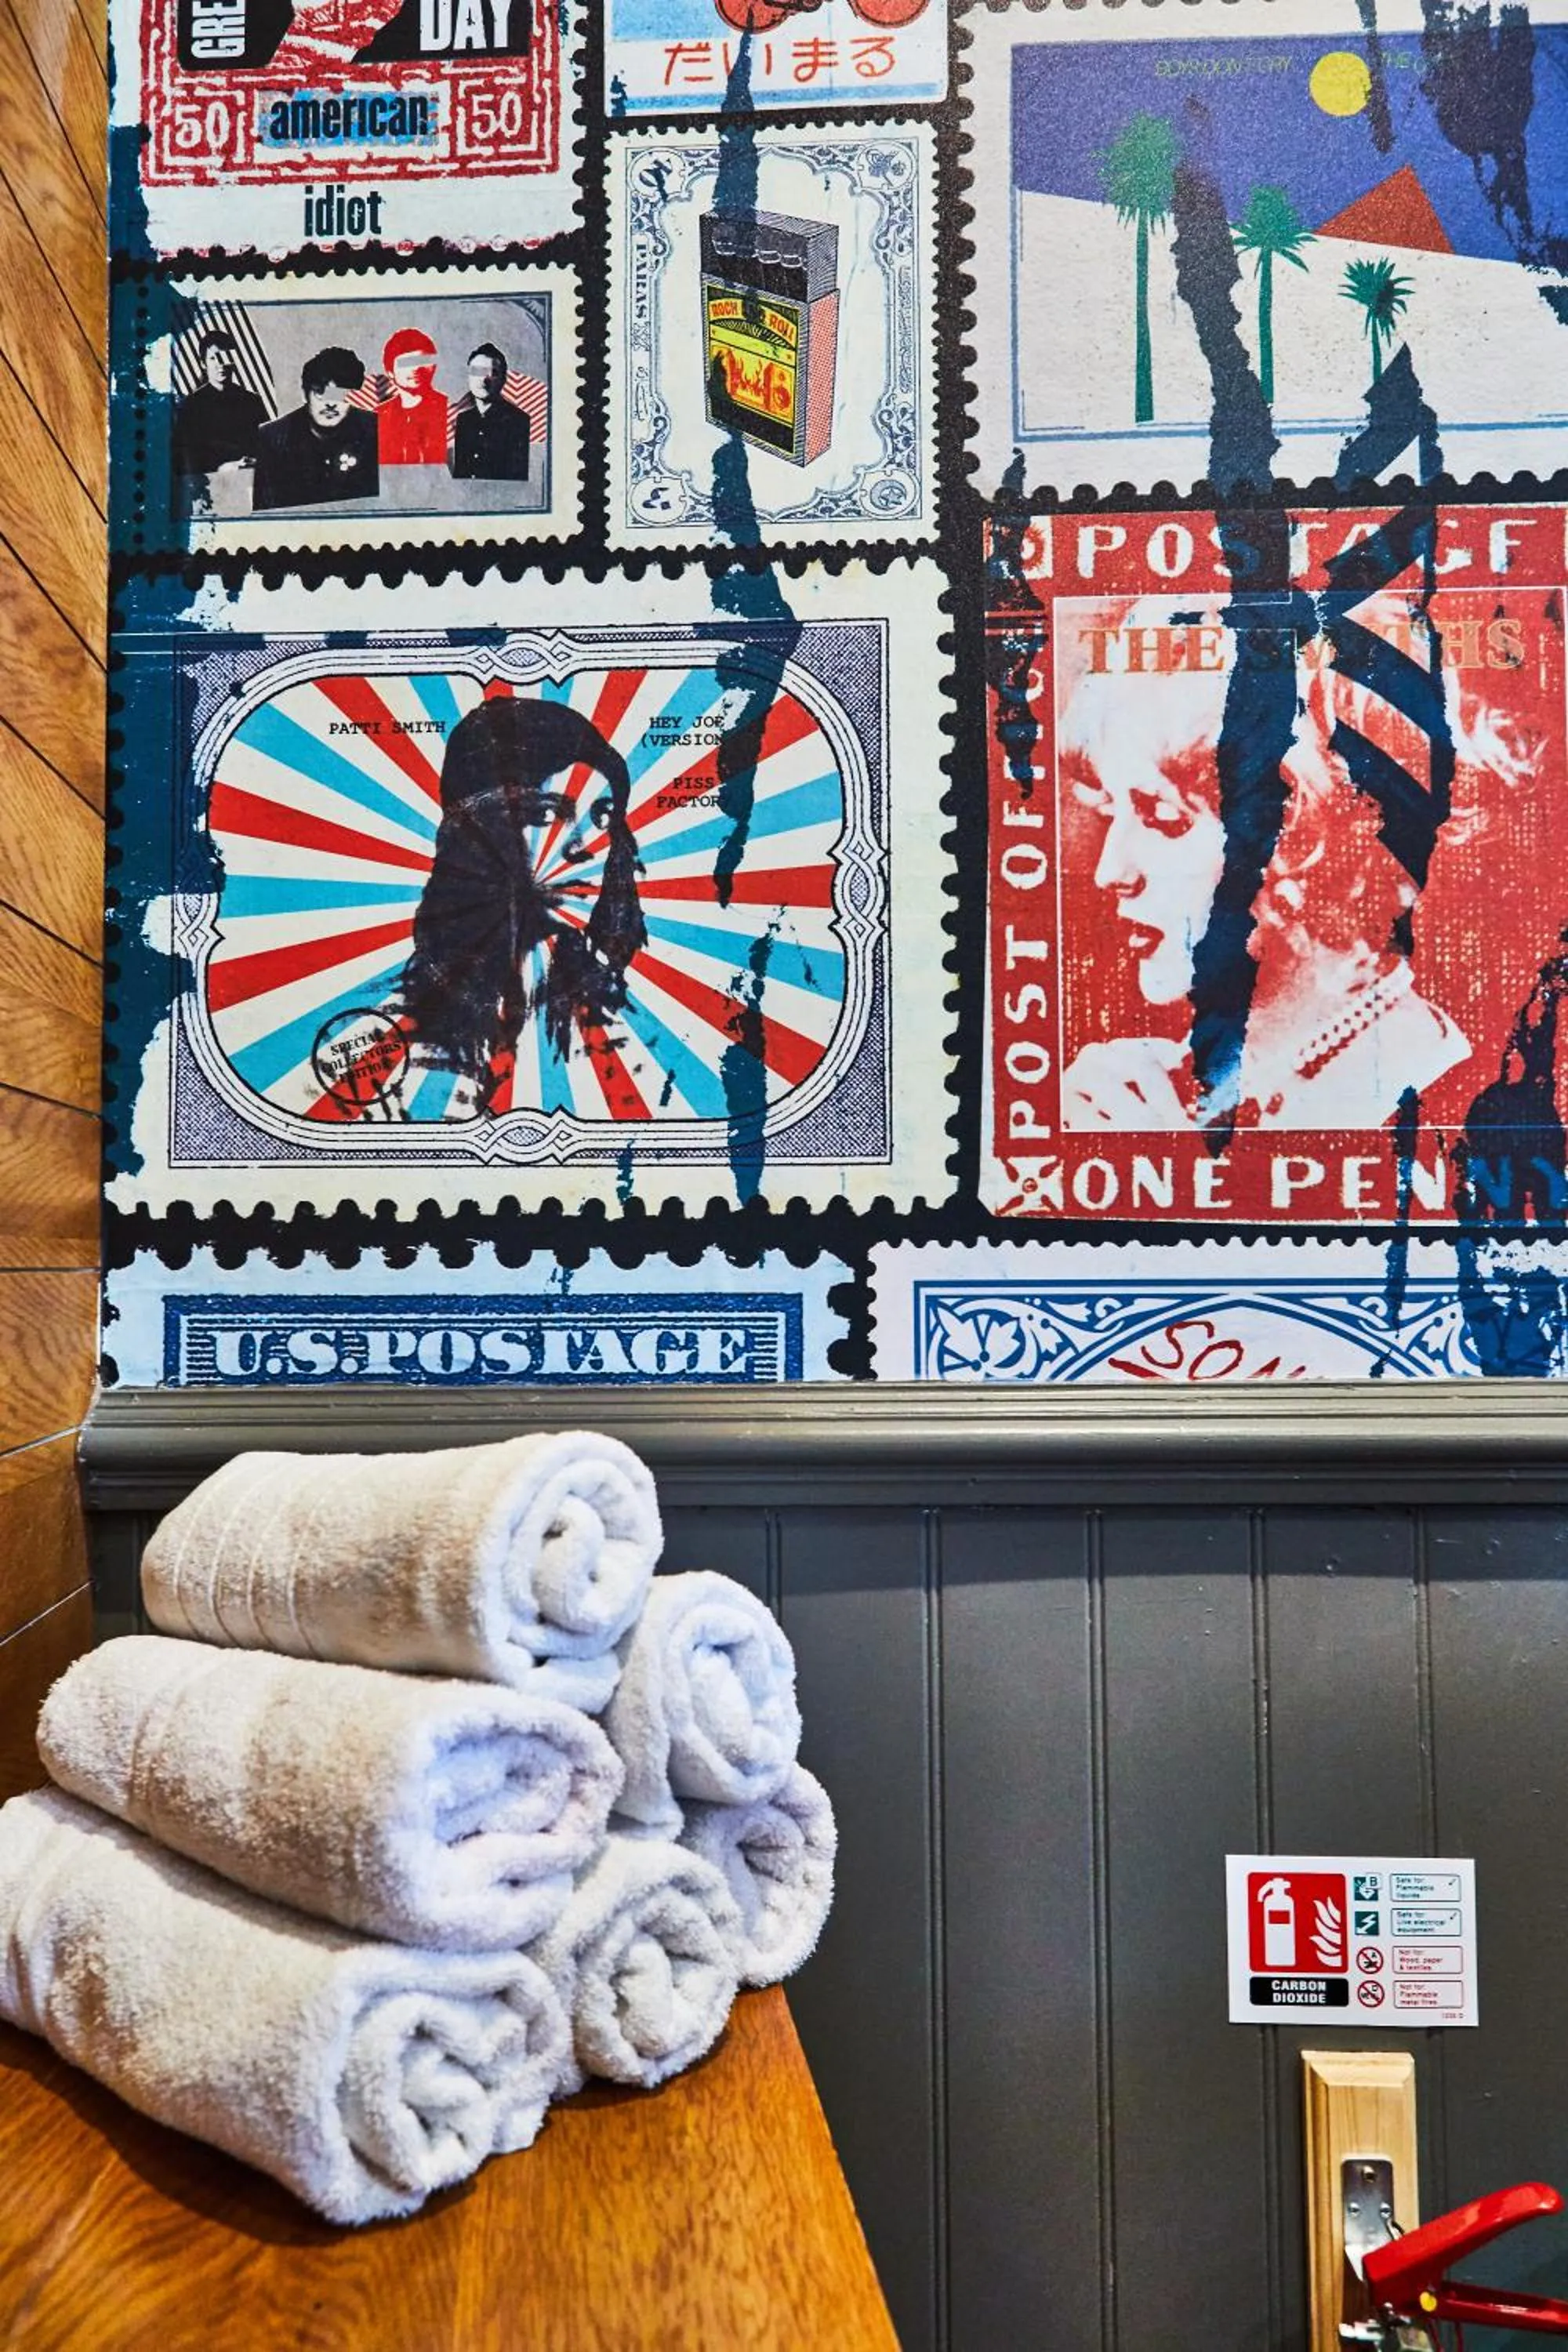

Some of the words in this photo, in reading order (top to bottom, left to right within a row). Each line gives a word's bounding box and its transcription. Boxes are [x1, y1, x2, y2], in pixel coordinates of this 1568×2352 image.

[419, 0, 511, 51] DAY
[175, 100, 231, 148] 50
[270, 95, 429, 140] american
[472, 92, 523, 140] 50
[304, 185, 385, 237] idiot
[636, 244, 647, 318] PARAS
[1079, 626, 1225, 673] THE
[329, 722, 382, 735] PATTI
[392, 720, 446, 734] SMITH
[649, 717, 682, 728] HEY
[692, 716, 725, 728] JOE
[657, 796, 723, 809] FACTOR
[673, 777, 715, 789] PISS
[330, 1031, 381, 1056] SPECIA
[1004, 926, 1051, 1140] POST
[1073, 1155, 1232, 1211] ONE
[1271, 1980, 1327, 1991] CARBON
[1272, 1992, 1327, 2004] DIOXIDE
